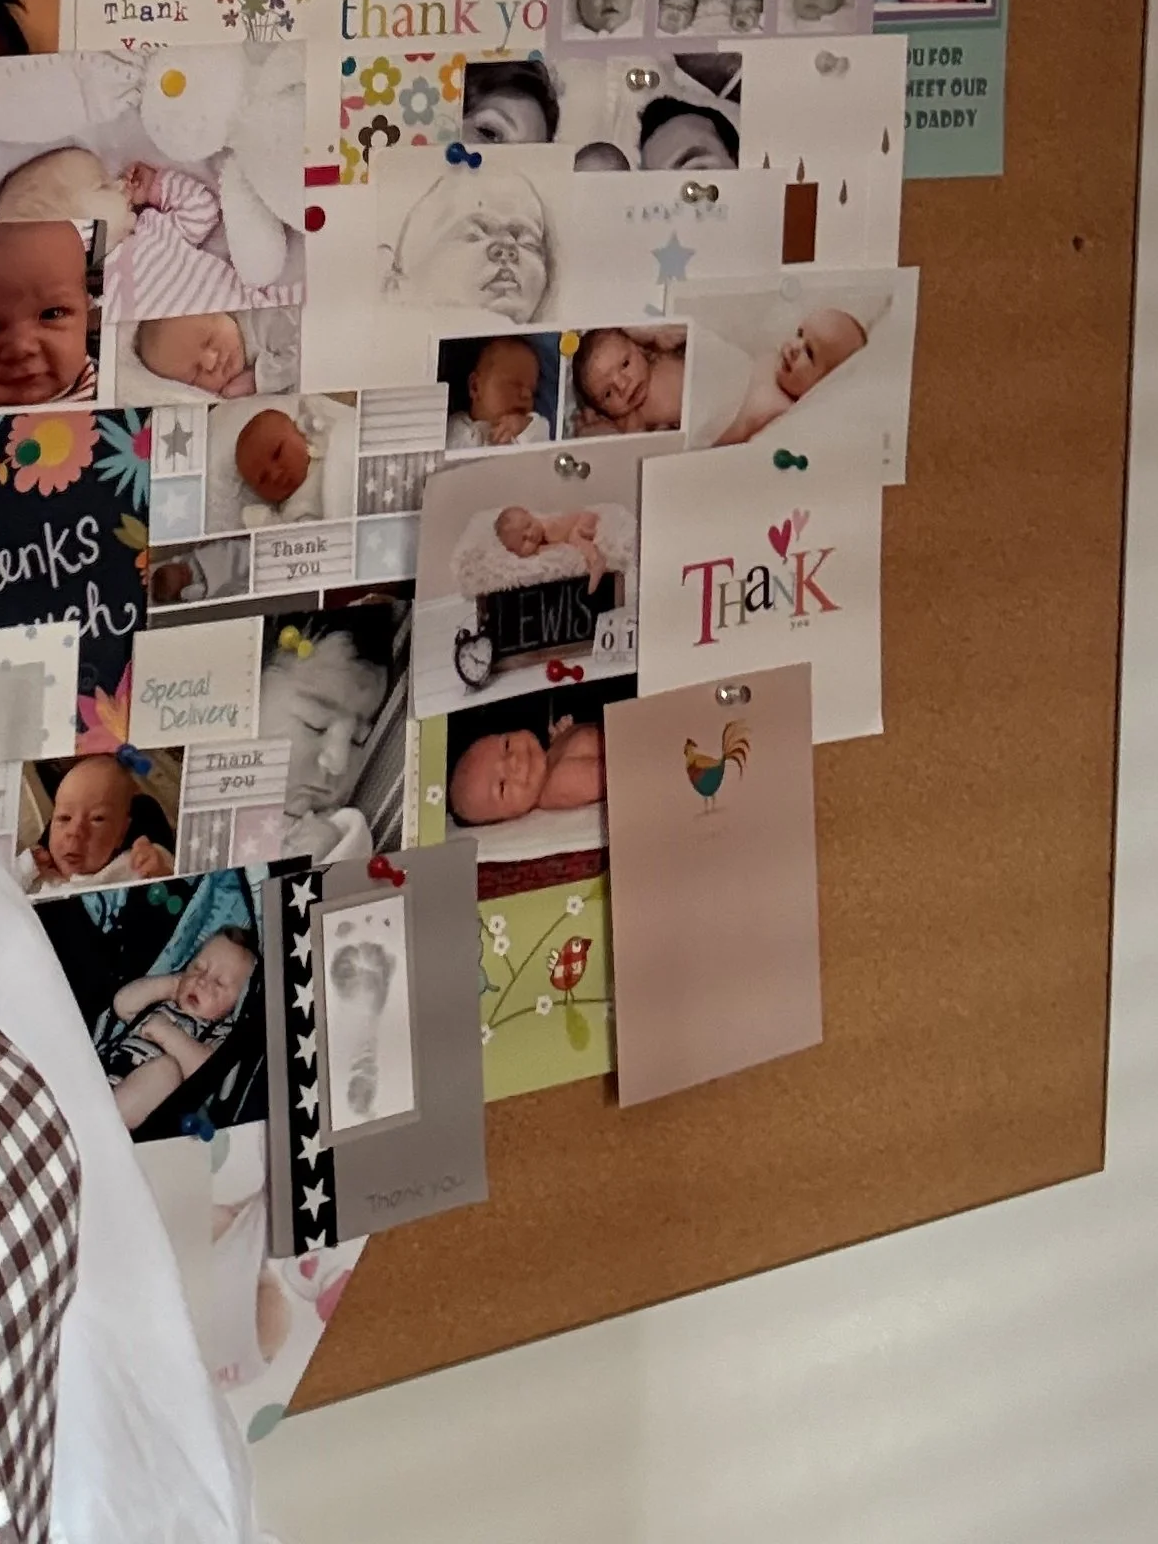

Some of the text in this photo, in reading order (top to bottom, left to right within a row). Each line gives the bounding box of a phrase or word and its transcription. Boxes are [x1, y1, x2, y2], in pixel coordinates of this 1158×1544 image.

[928, 46, 964, 67] FOR
[951, 77, 988, 98] OUR
[916, 108, 978, 130] DADDY
[271, 536, 329, 558] Thank
[286, 560, 321, 581] you
[496, 581, 593, 653] LEWIS
[140, 671, 211, 709] Special
[159, 703, 240, 732] Delivery
[205, 750, 265, 772] Thank
[219, 774, 257, 794] you
